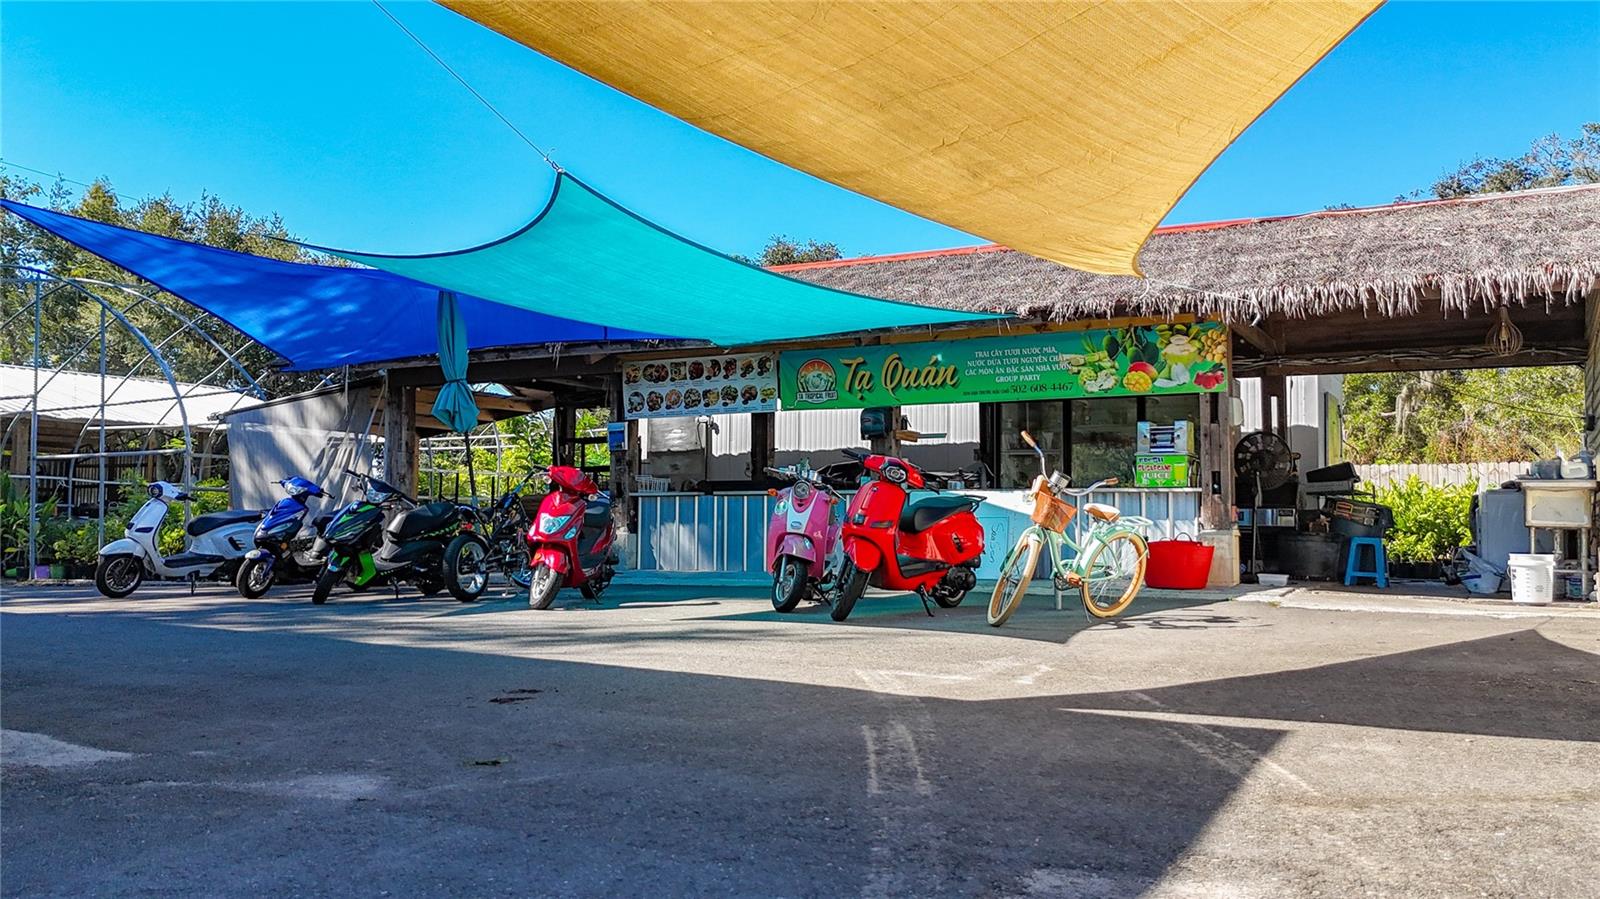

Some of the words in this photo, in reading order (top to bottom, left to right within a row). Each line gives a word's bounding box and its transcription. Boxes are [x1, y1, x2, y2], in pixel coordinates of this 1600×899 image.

[840, 356, 873, 400] Tạ
[881, 352, 958, 398] Quán
[995, 375, 1018, 383] GROUP
[1019, 374, 1041, 382] PARTY
